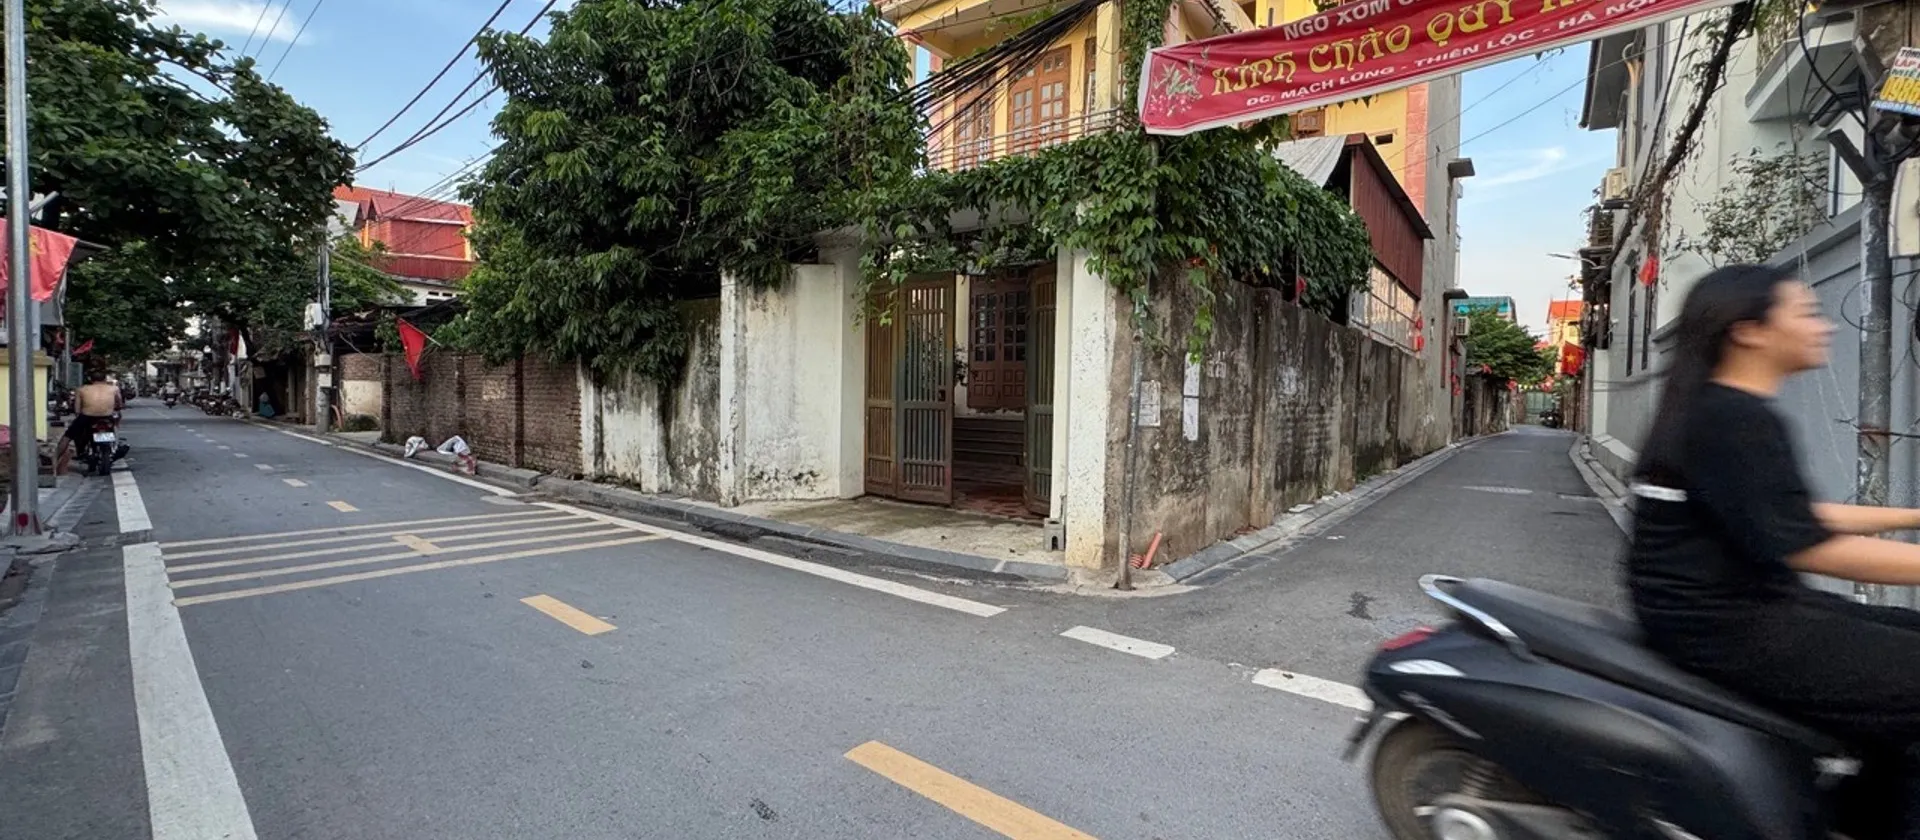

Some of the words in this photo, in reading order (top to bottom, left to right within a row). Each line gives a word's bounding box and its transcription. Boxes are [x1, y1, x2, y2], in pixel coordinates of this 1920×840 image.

[1280, 79, 1335, 99] MẠCH
[1413, 44, 1480, 69] THIÊN
[1486, 29, 1536, 49] LỘC
[1307, 25, 1411, 74] CHÀO
